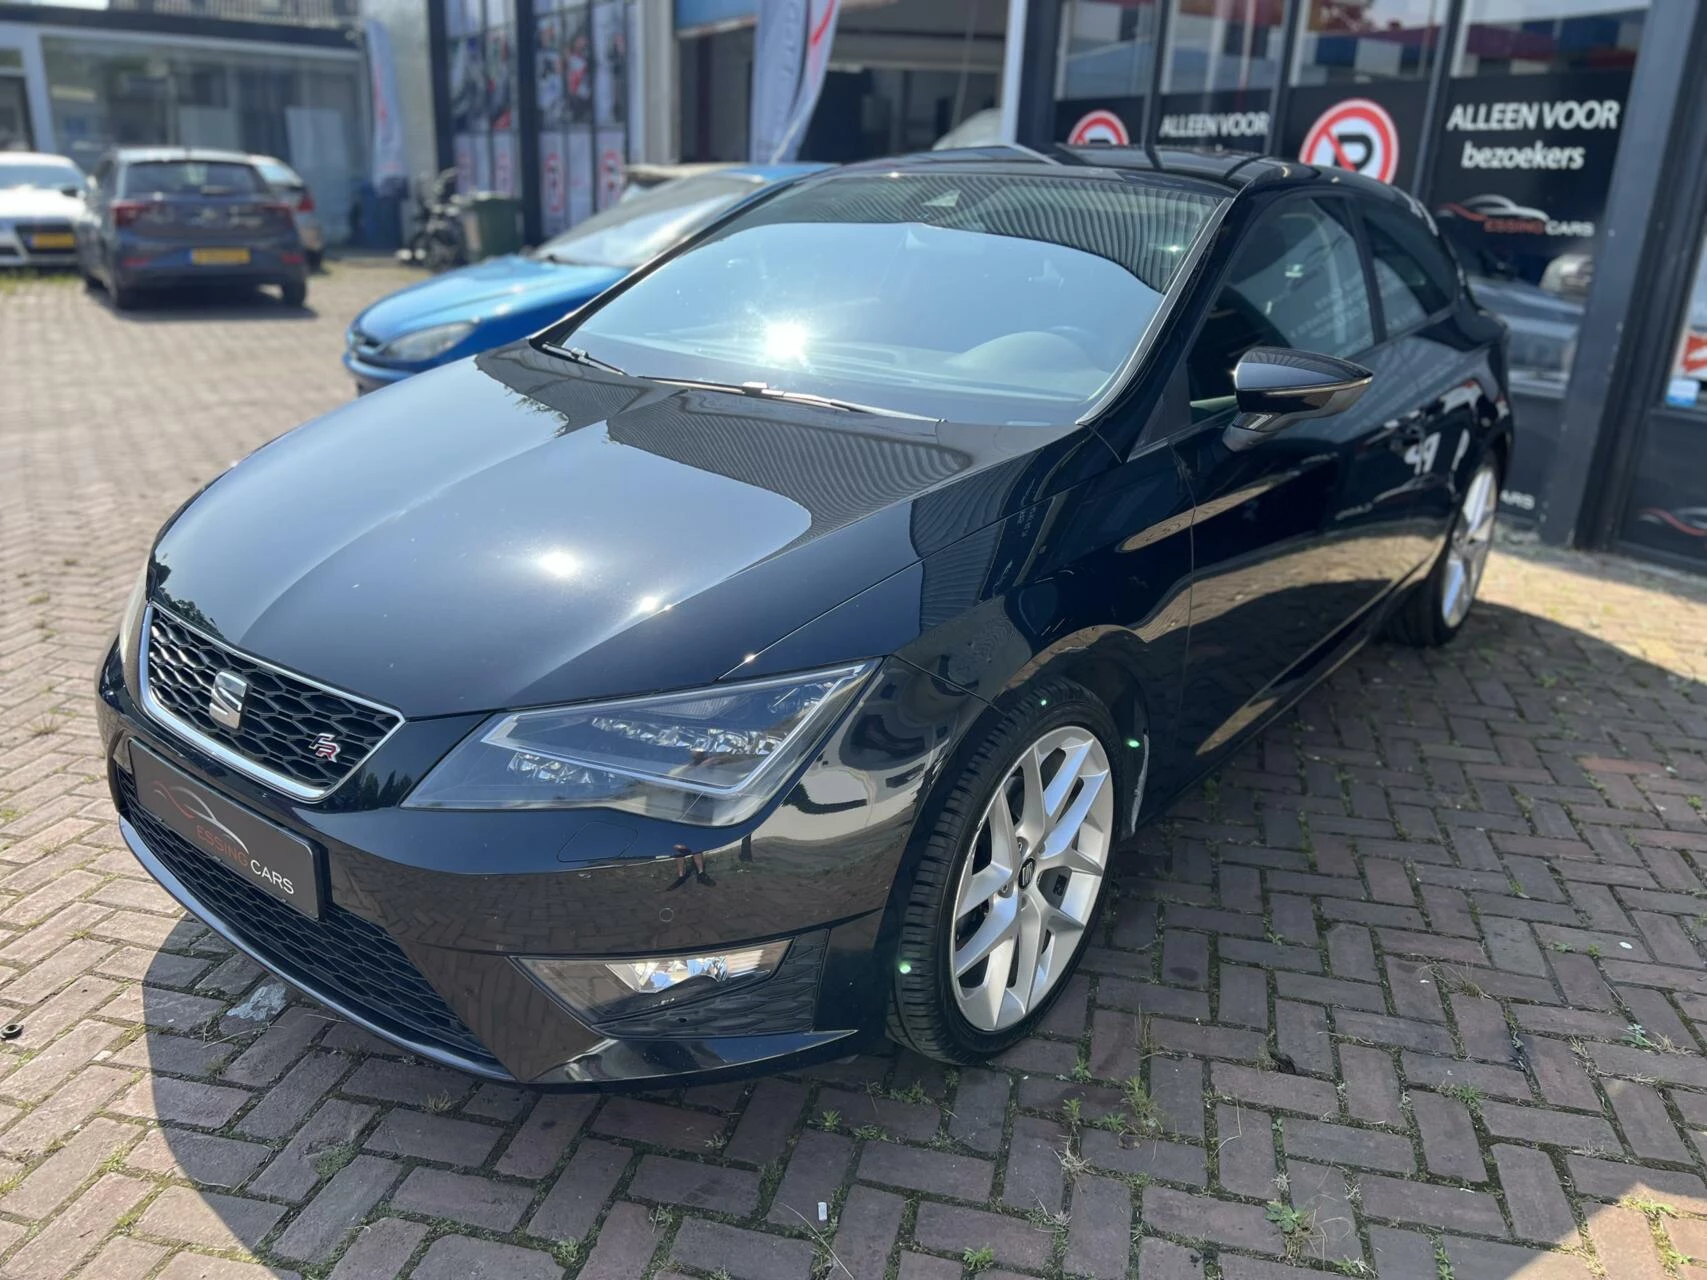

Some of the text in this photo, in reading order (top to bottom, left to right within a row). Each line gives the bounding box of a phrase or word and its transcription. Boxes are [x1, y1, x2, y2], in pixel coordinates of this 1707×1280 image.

[1159, 111, 1270, 137] ALLEEN VOOR
[1447, 100, 1620, 132] ALLEEN VOOR
[1460, 139, 1586, 169] bezoekers
[1545, 219, 1595, 237] CARS
[308, 732, 341, 763] FR
[196, 824, 294, 895] ESSING CARS
